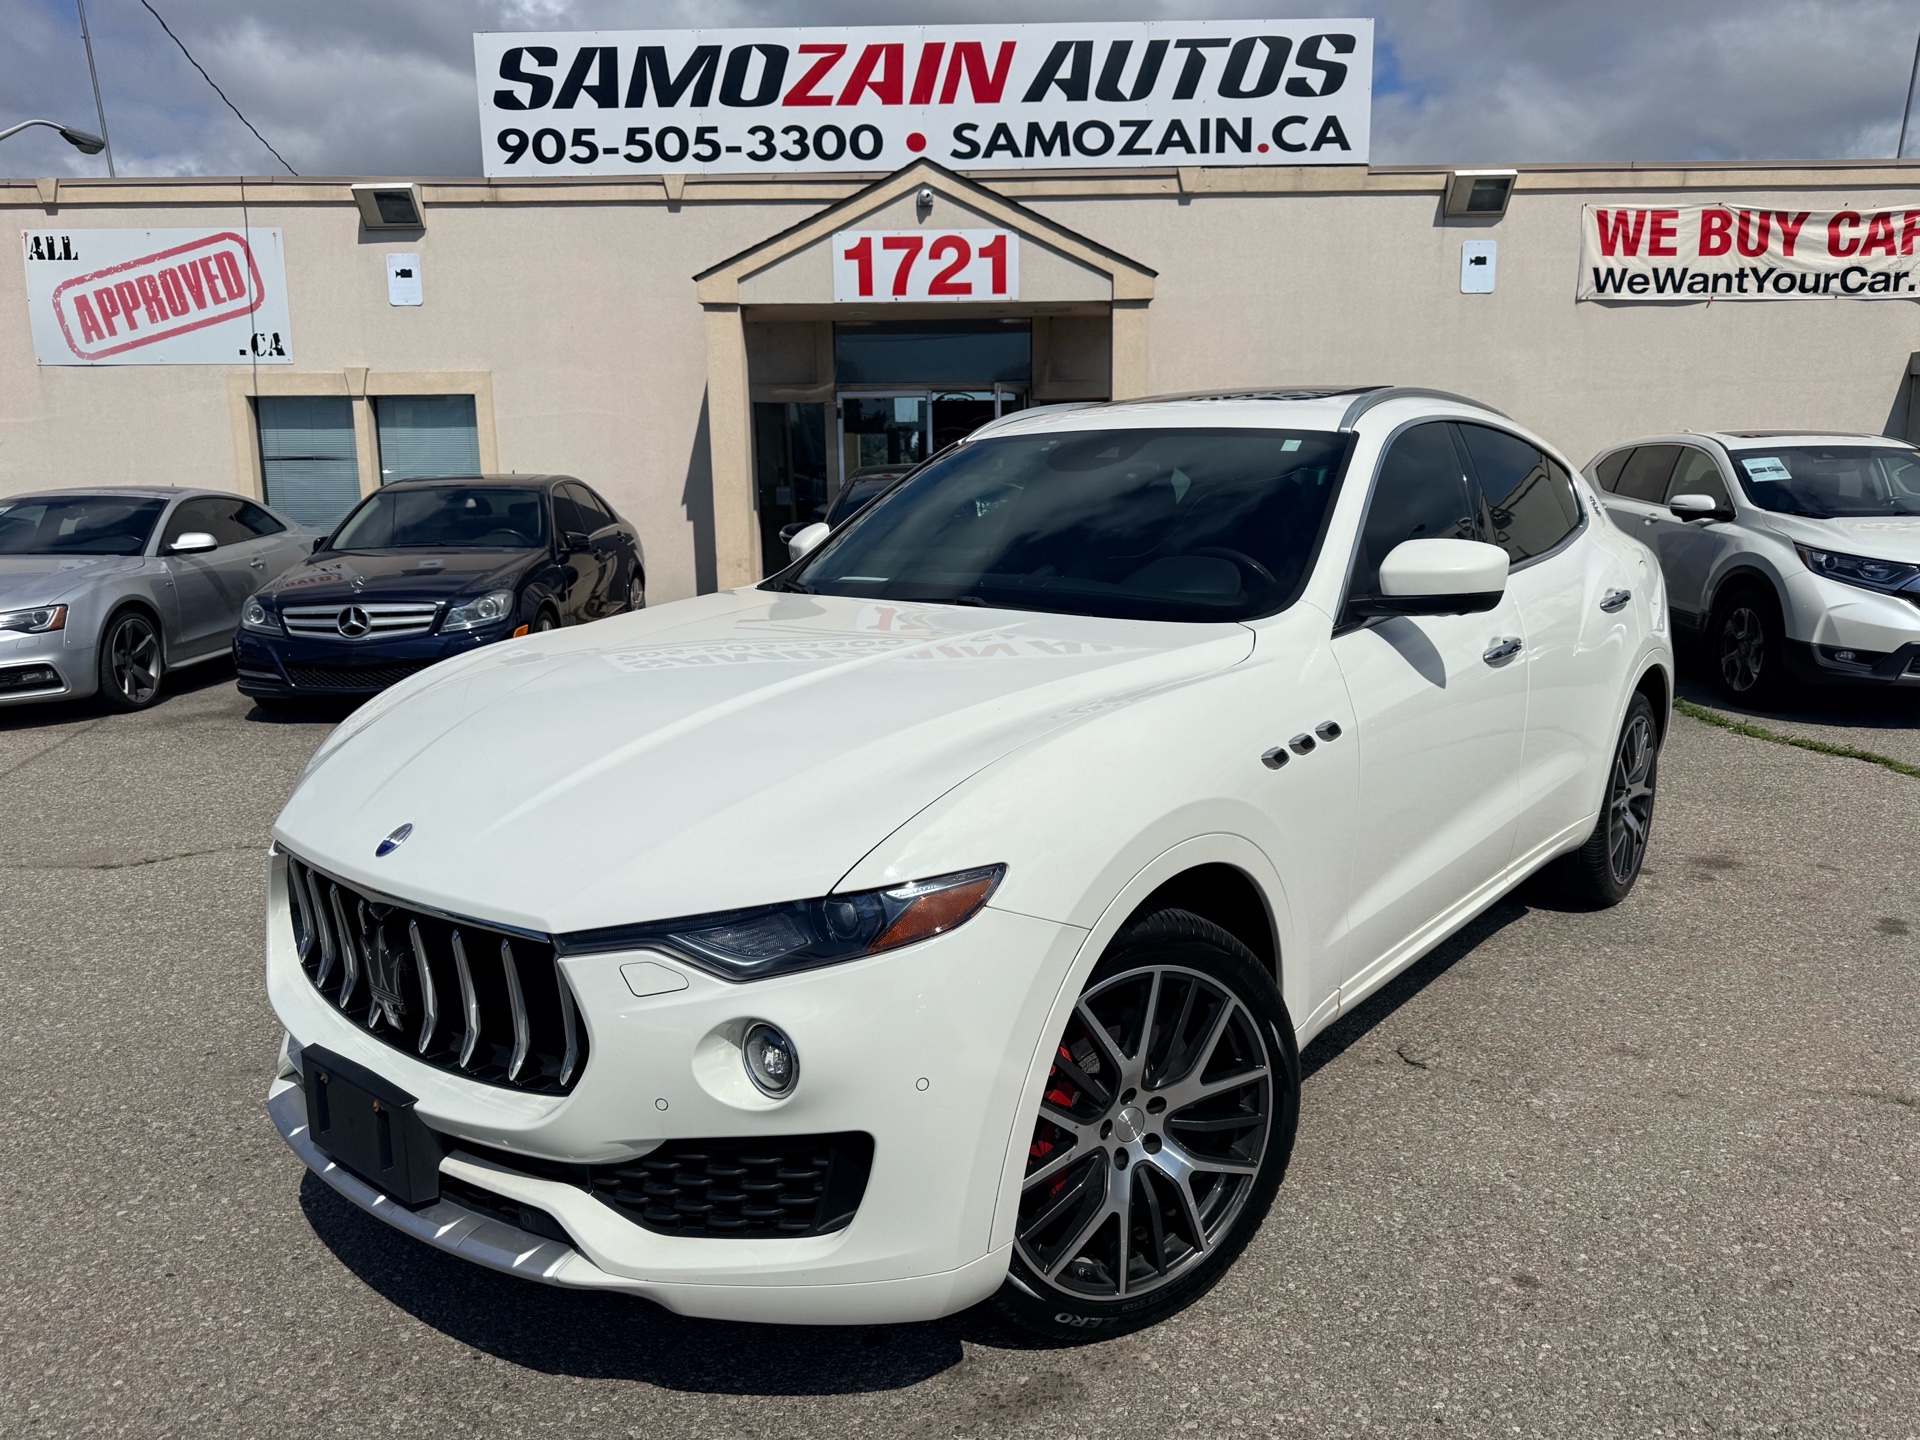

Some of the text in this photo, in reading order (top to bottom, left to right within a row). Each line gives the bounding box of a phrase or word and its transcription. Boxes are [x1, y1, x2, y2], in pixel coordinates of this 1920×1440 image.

[493, 33, 1357, 111] SAMOZAIN AUTOS
[496, 115, 1353, 164] 905-505-3300 SAMOZAIN.CA
[28, 236, 79, 260] ALL
[1596, 209, 1679, 257] WE
[1698, 209, 1811, 257] BUY
[843, 234, 1008, 297] 1721
[1593, 266, 1916, 294] WeWantYourCar.
[73, 250, 247, 345] APPROVED
[239, 332, 286, 357] .CA
[1054, 1312, 1119, 1328] ZERO
